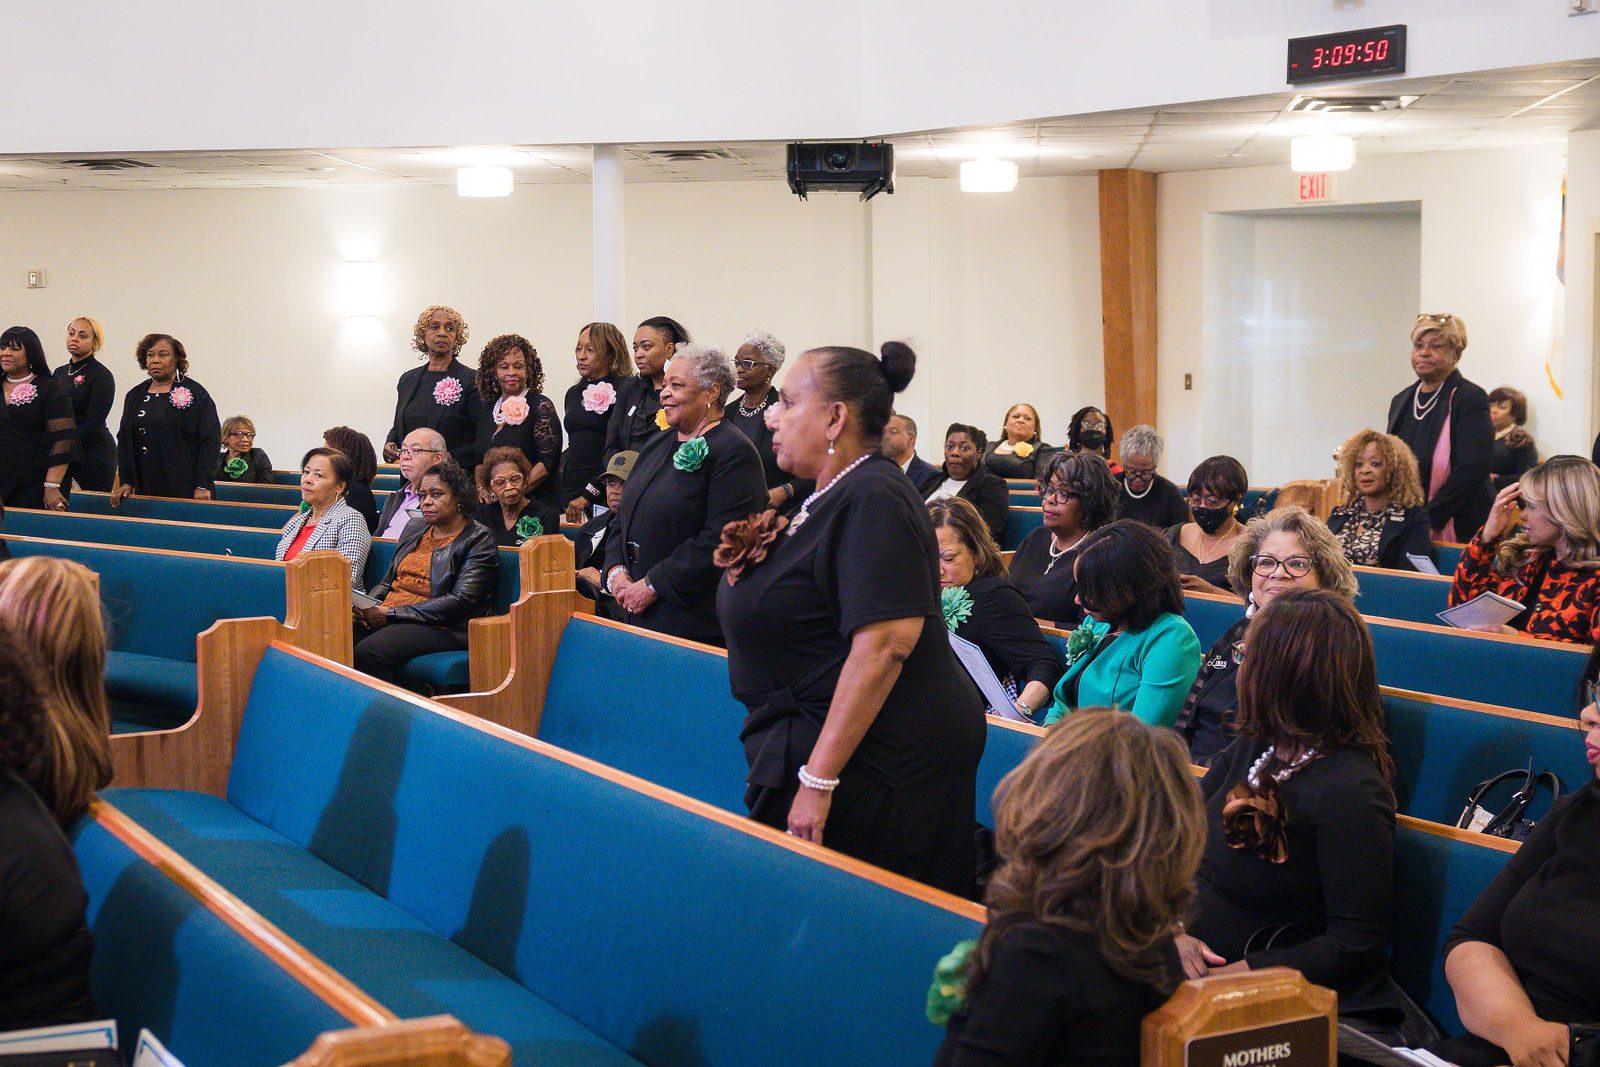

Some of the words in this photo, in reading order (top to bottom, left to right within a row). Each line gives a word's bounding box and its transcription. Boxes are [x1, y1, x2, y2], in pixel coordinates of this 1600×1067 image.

[1312, 39, 1389, 69] 3:09:50
[1300, 174, 1327, 199] EXIT
[1223, 1041, 1292, 1067] MOTHERS
